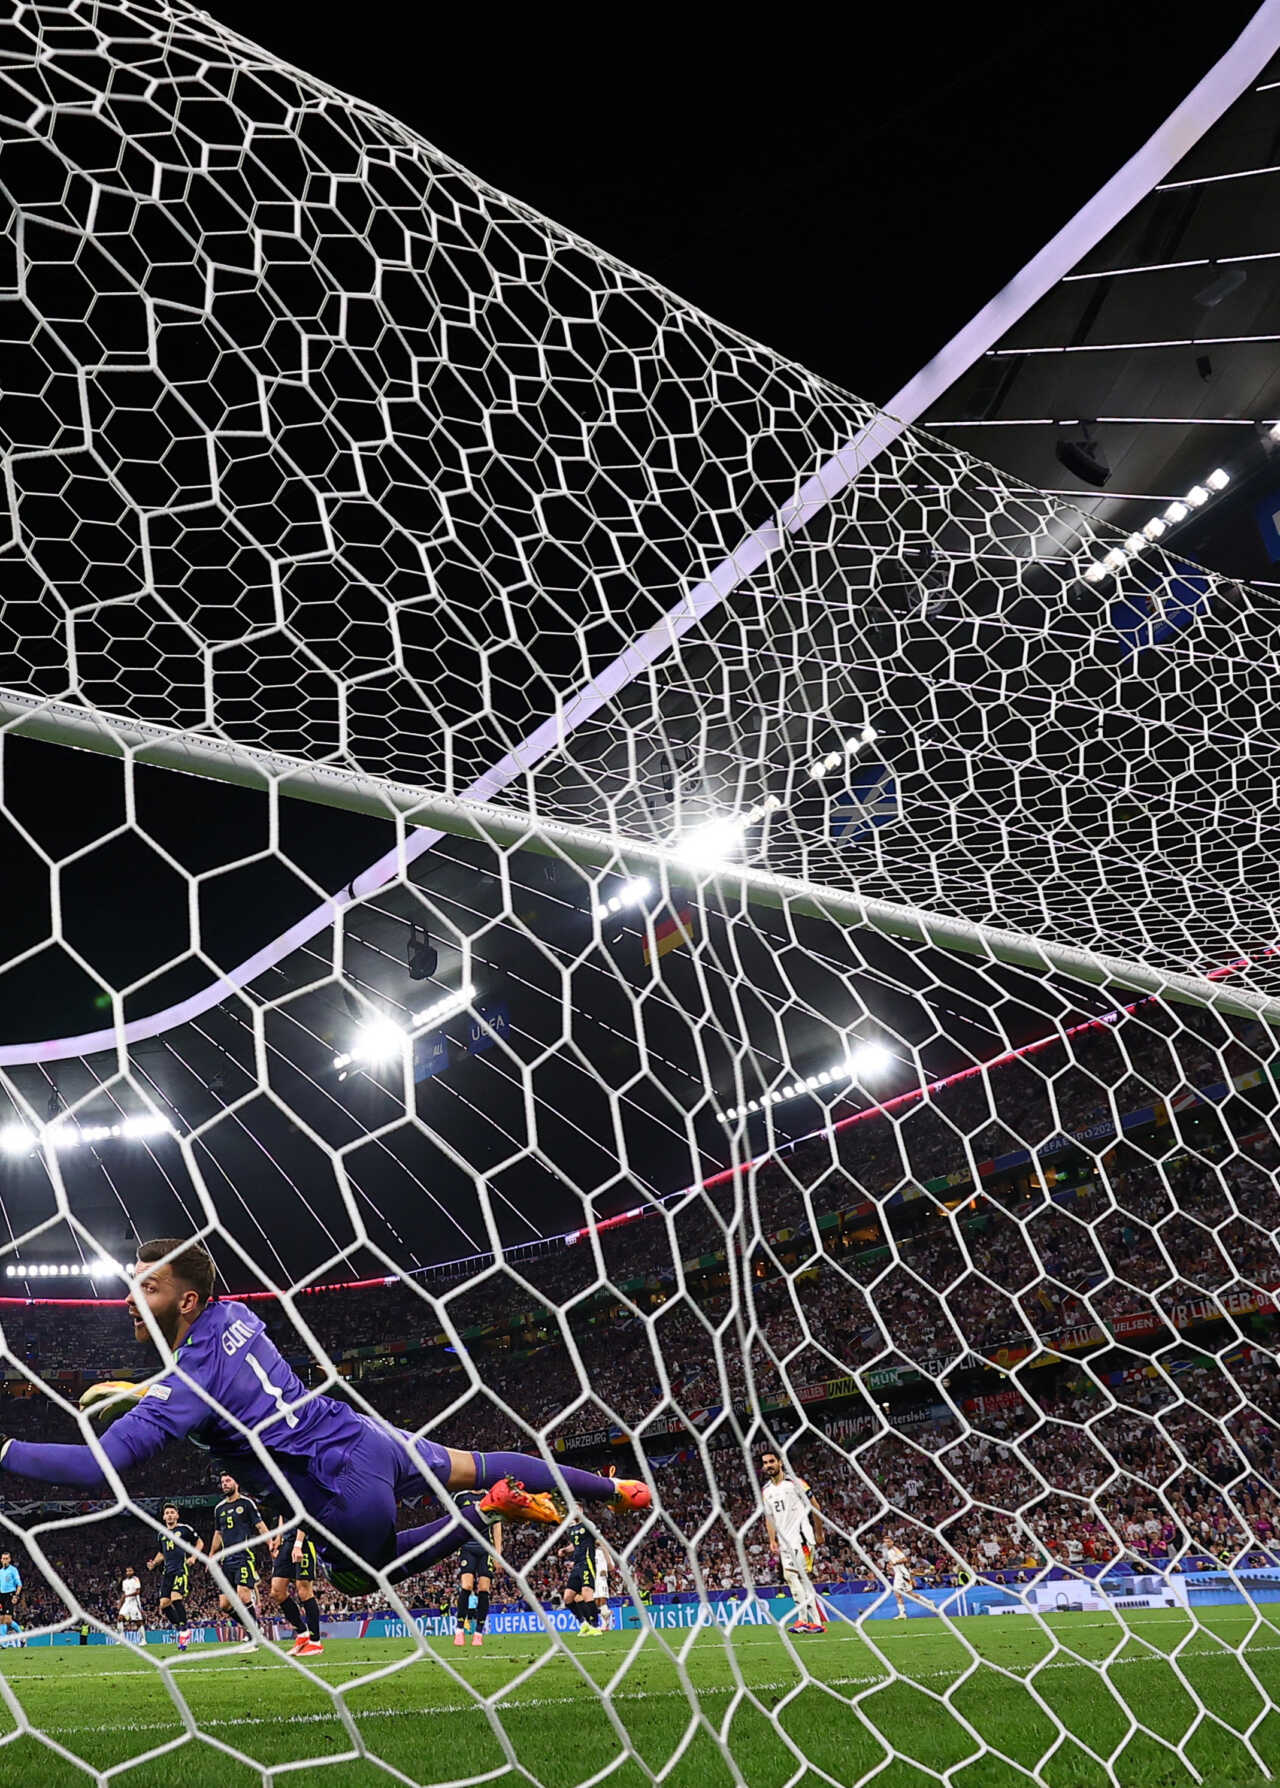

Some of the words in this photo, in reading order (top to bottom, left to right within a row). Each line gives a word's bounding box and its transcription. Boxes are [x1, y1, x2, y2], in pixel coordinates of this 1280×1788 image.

[245, 1352, 300, 1429] 1
[565, 1431, 608, 1449] HARZBURG
[773, 1499, 786, 1512] 21
[226, 1516, 234, 1528] 5
[166, 1539, 175, 1551] 14
[574, 1535, 580, 1546] 2
[240, 1567, 249, 1578] 5
